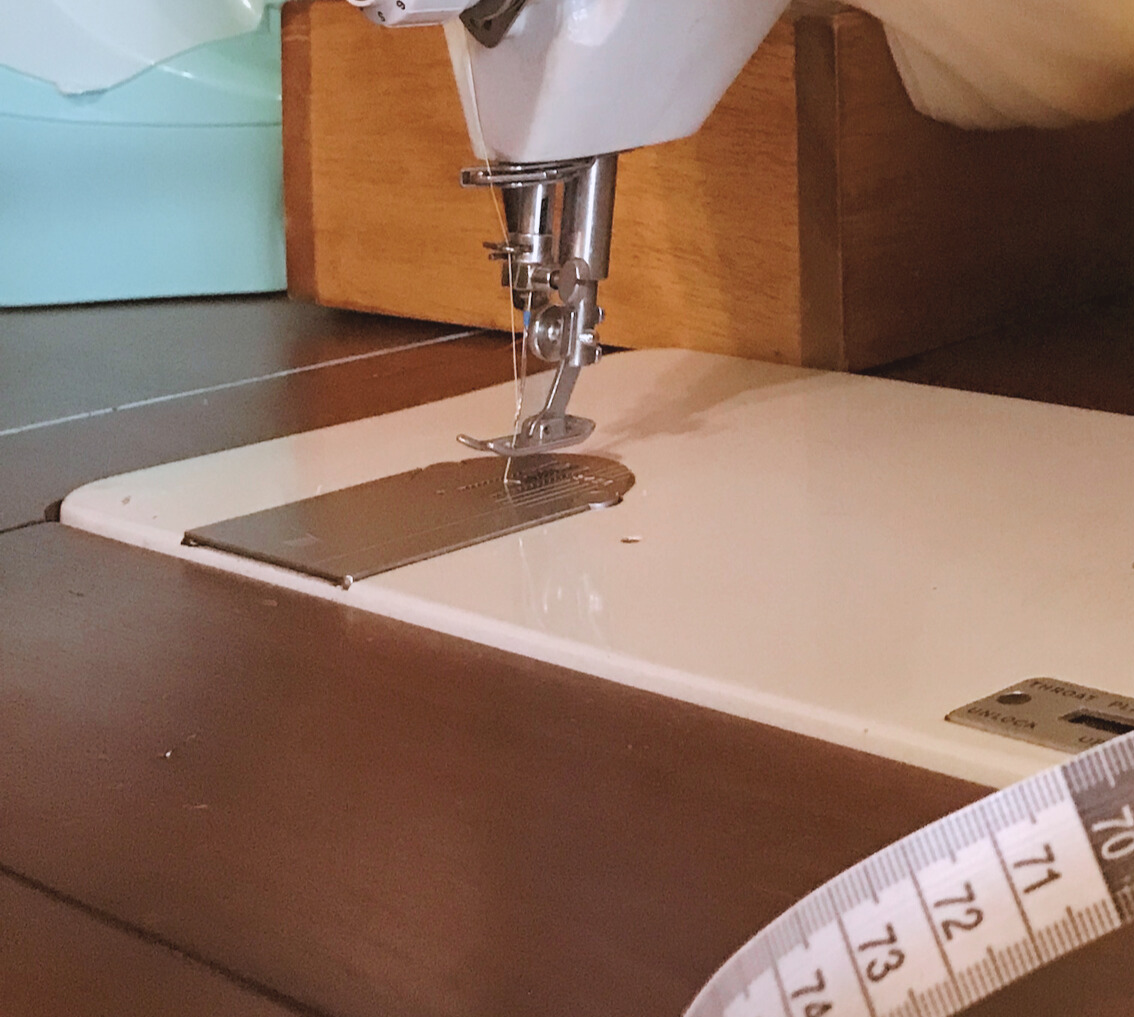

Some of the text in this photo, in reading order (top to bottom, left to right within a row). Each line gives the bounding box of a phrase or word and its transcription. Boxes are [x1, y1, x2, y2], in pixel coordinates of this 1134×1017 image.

[1013, 843, 1062, 894] 71
[933, 881, 984, 941] 72
[858, 922, 906, 983] 73
